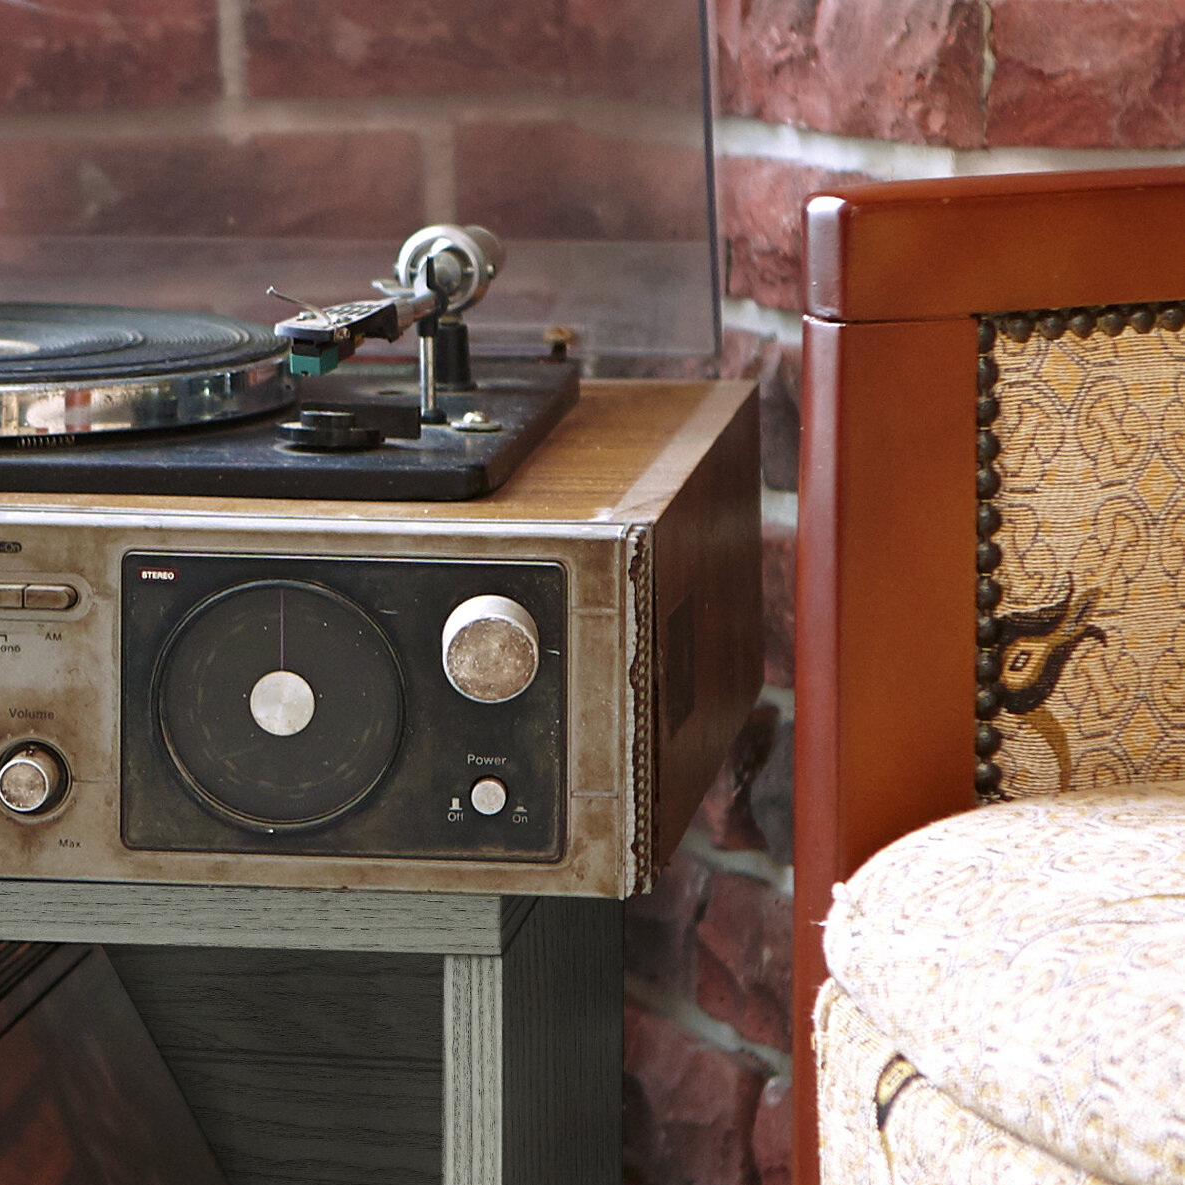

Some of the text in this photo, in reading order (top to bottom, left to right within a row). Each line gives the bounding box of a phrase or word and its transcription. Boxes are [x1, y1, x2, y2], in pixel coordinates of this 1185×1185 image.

[141, 571, 174, 580] STEREO
[44, 632, 62, 641] AM
[8, 708, 55, 720] Volume
[467, 754, 507, 766] Power
[447, 811, 464, 822] Off
[512, 814, 528, 823] On
[59, 838, 81, 848] Max
